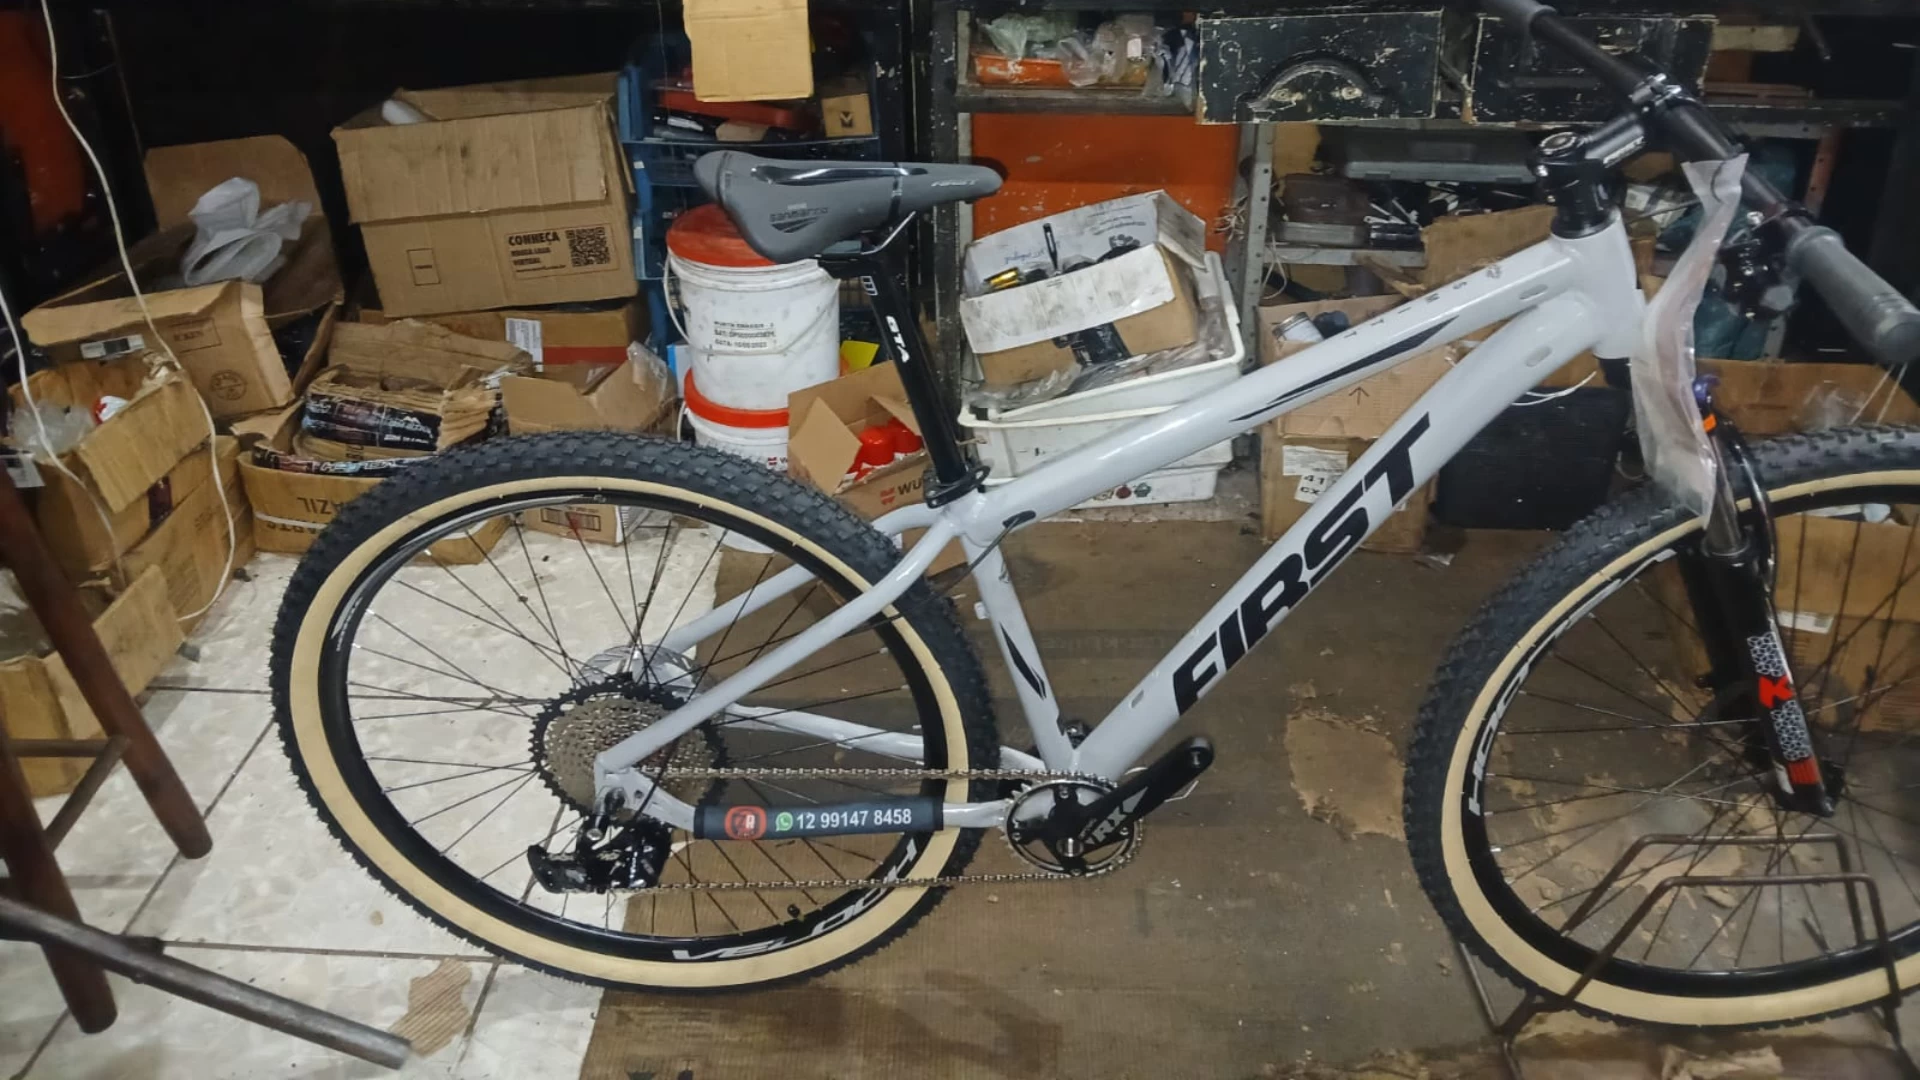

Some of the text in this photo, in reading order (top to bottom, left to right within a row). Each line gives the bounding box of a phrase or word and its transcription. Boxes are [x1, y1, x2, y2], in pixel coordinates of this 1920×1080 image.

[1173, 411, 1430, 716] FIRST
[796, 812, 816, 829] 12
[820, 810, 870, 829] 99147
[873, 808, 913, 826] 8458
